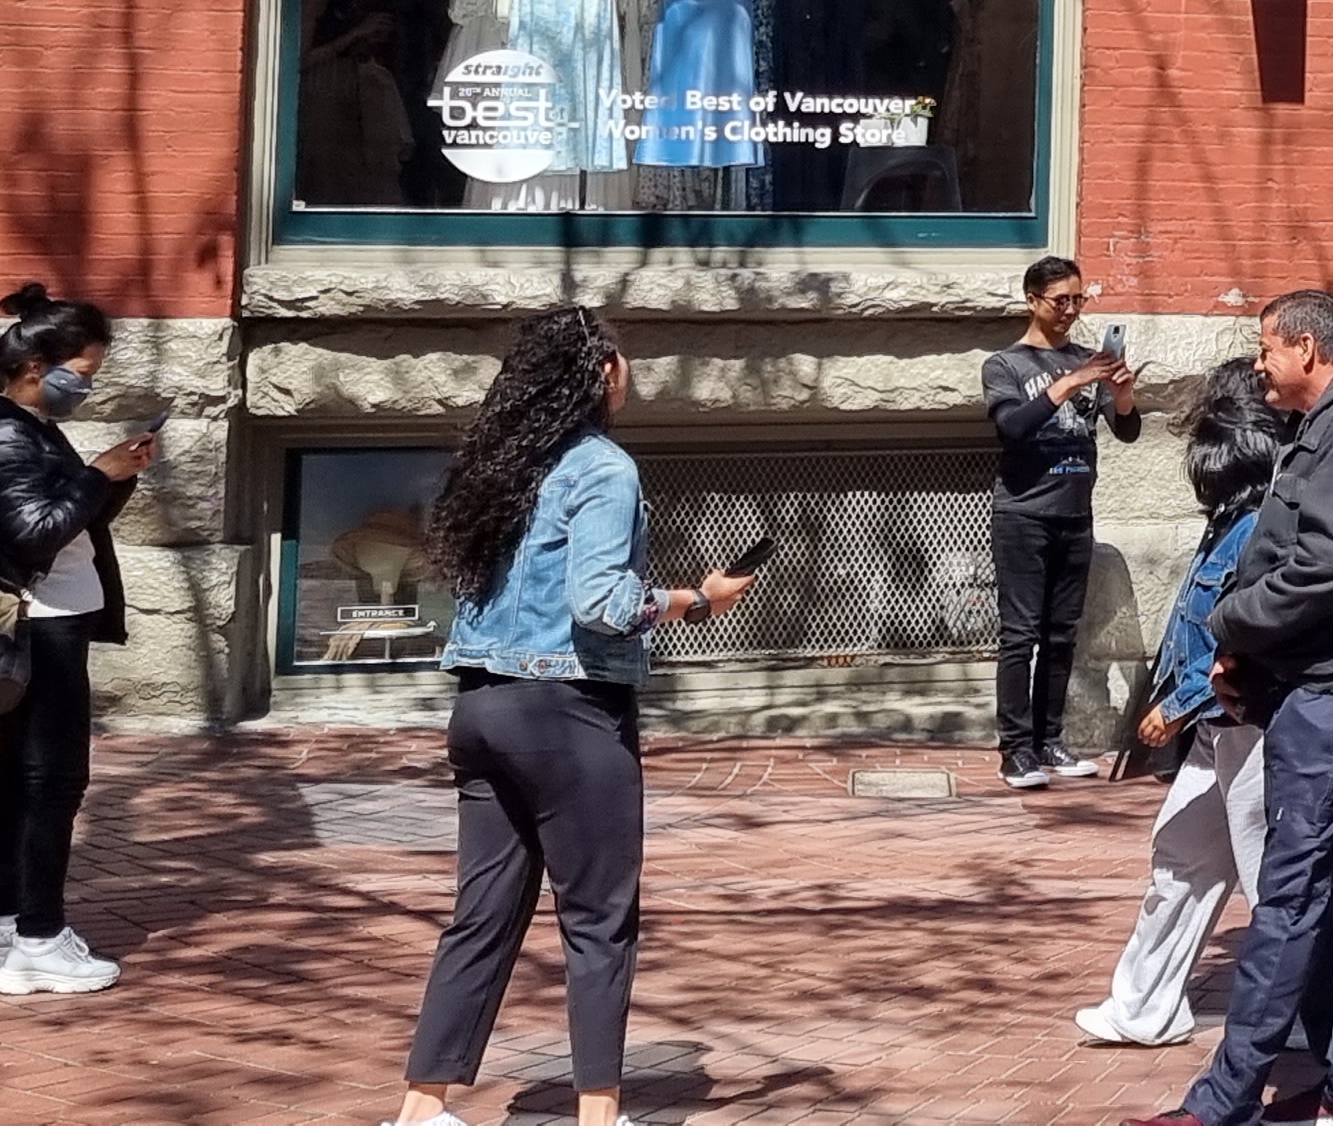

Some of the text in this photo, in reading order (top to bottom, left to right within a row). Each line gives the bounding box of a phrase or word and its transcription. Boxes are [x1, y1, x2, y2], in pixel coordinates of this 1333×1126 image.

[461, 61, 545, 79] straight
[483, 87, 532, 98] ANNUAL
[434, 86, 566, 128] best
[685, 90, 742, 111] Best
[749, 90, 778, 113] of
[783, 92, 918, 114] Vancouver
[442, 129, 563, 146] vancouve
[724, 120, 832, 149] Clothing
[838, 122, 906, 144] Store
[351, 609, 405, 618] ENTRANCE
